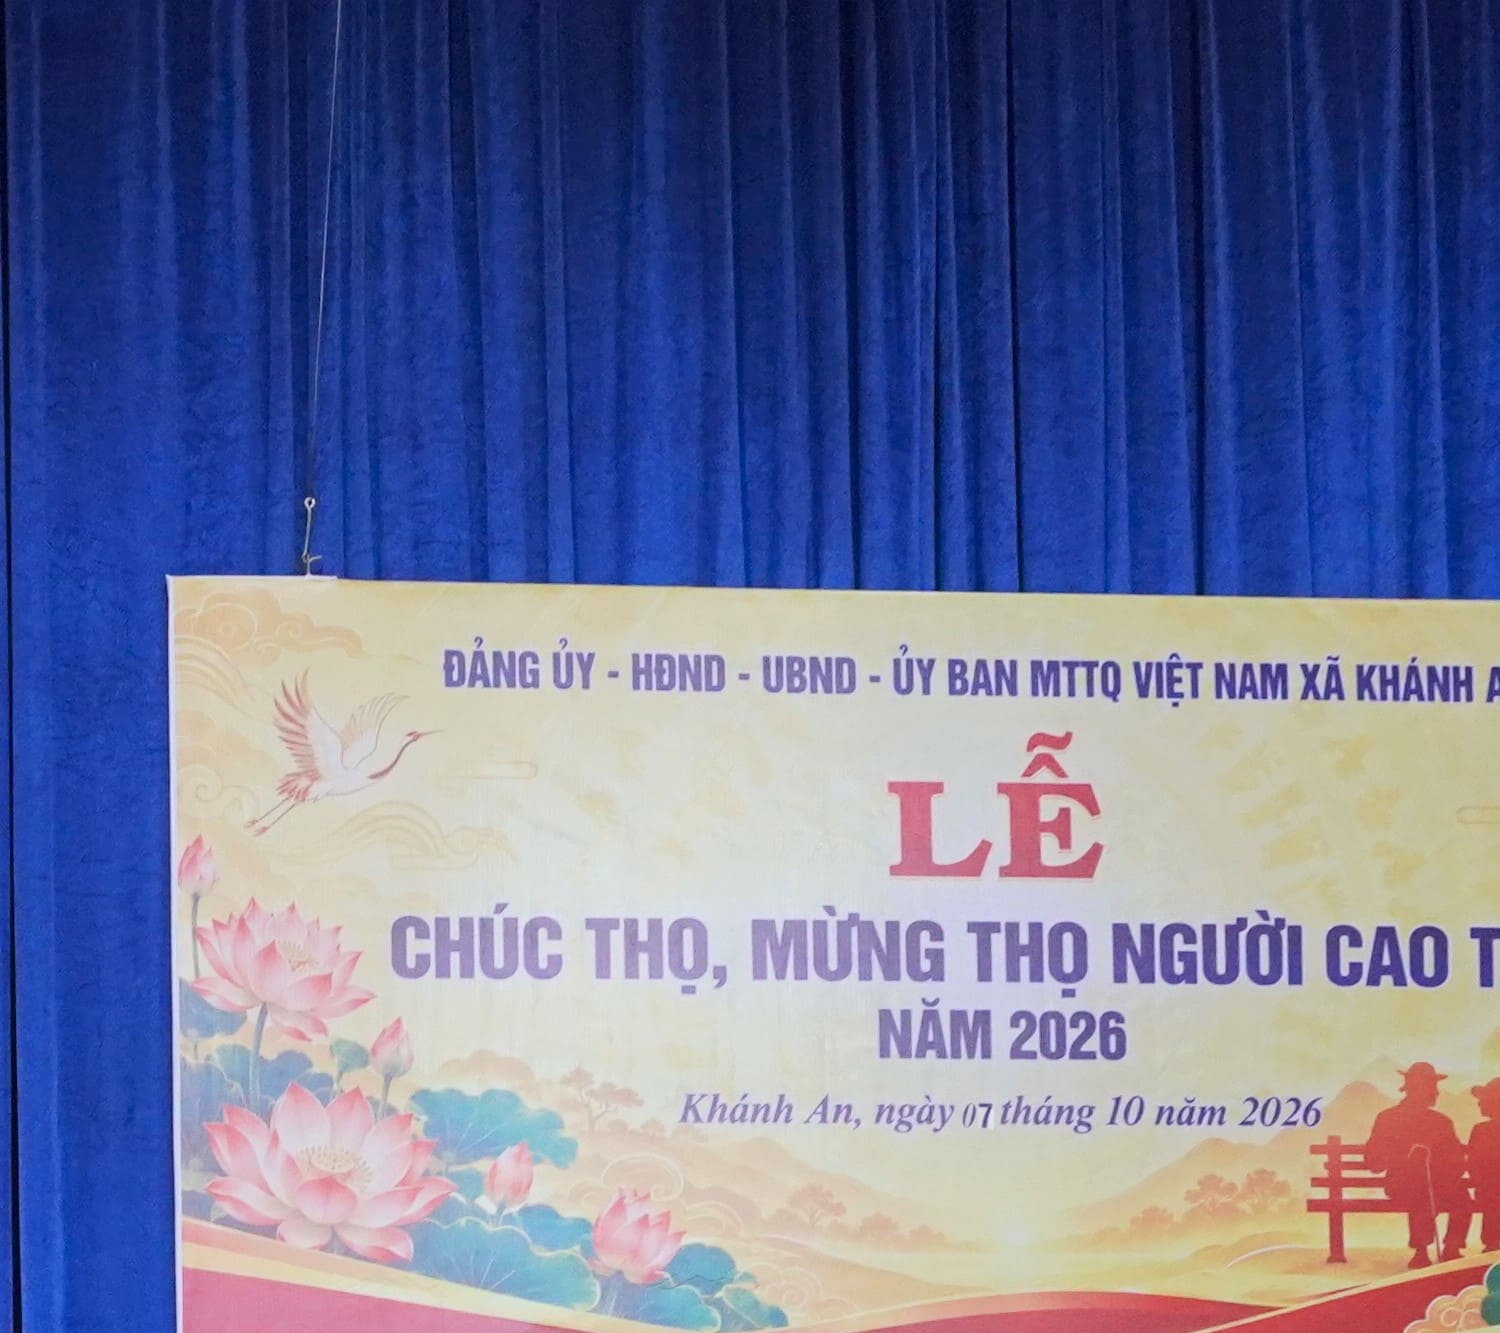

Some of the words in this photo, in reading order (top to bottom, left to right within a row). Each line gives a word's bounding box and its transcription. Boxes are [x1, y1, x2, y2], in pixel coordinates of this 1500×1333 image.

[443, 634, 540, 689] ĐẢNG
[552, 637, 595, 690] ỦY
[632, 653, 726, 692] HĐND
[763, 655, 857, 694] UBND
[893, 645, 936, 696] ỦY
[948, 657, 1017, 697] BAN
[1031, 659, 1121, 702] MTTQ
[1133, 653, 1203, 708] VIỆT
[1215, 662, 1288, 700] NAM
[1301, 656, 1345, 700] XÃ
[1357, 656, 1473, 702] KHÁNH
[888, 731, 1104, 881] LỄ
[391, 903, 562, 980] CHÚC
[585, 917, 728, 995] THỌ,
[751, 905, 945, 983] MỪNG
[967, 920, 1088, 998] THỌ
[1112, 909, 1303, 987] NGƯỜI
[1325, 924, 1449, 988] CAO
[878, 997, 992, 1060] NĂM
[1009, 1010, 1127, 1061] 2026
[678, 1093, 794, 1126] Khánh
[804, 1101, 860, 1130] An,
[875, 1106, 955, 1133] ngày
[961, 1102, 992, 1129] 07
[1000, 1096, 1095, 1134] tháng
[1106, 1096, 1145, 1127] 10
[1155, 1097, 1227, 1127] năm
[1239, 1097, 1323, 1128] 2026
